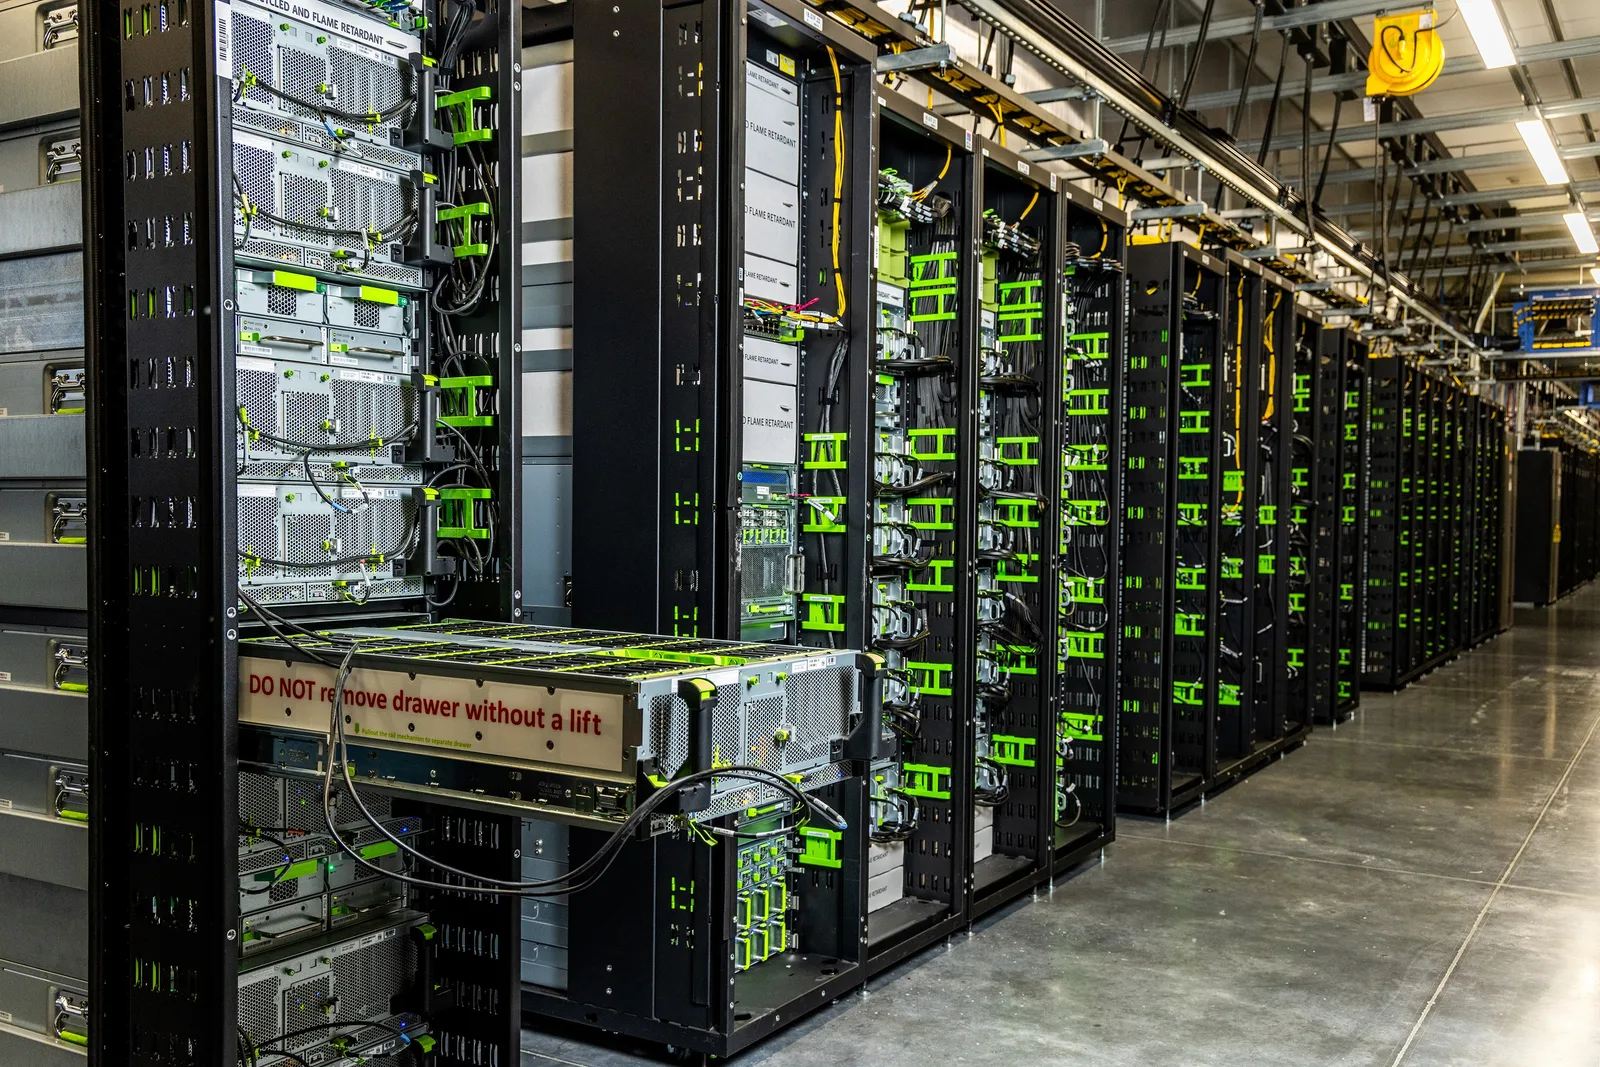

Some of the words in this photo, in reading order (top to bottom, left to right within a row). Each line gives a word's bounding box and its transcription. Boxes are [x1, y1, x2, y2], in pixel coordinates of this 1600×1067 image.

[292, 4, 310, 19] AND
[312, 12, 339, 30] FLAME
[341, 22, 384, 45] RETARDANT
[758, 74, 779, 90] RETARDANT
[750, 121, 767, 137] FLAME
[768, 129, 796, 148] RETARDANT
[749, 206, 766, 220] FLAME
[767, 212, 796, 229] RETARDANT
[756, 273, 778, 285] RETARDANT
[745, 353, 757, 362] FLAME
[757, 355, 779, 365] RETARDANT
[747, 416, 764, 427] FLAME
[765, 418, 794, 430] RETARDANT
[250, 674, 274, 696] DO
[279, 677, 316, 701] NOT
[320, 686, 388, 709] remove
[392, 689, 460, 718] drawer
[465, 699, 545, 729] without
[551, 713, 563, 731] a
[569, 708, 602, 736] lift
[361, 728, 379, 736] Pullout
[379, 730, 387, 738] the
[397, 733, 424, 742] mechanism
[431, 737, 453, 747] separate
[453, 740, 472, 748] drawer
